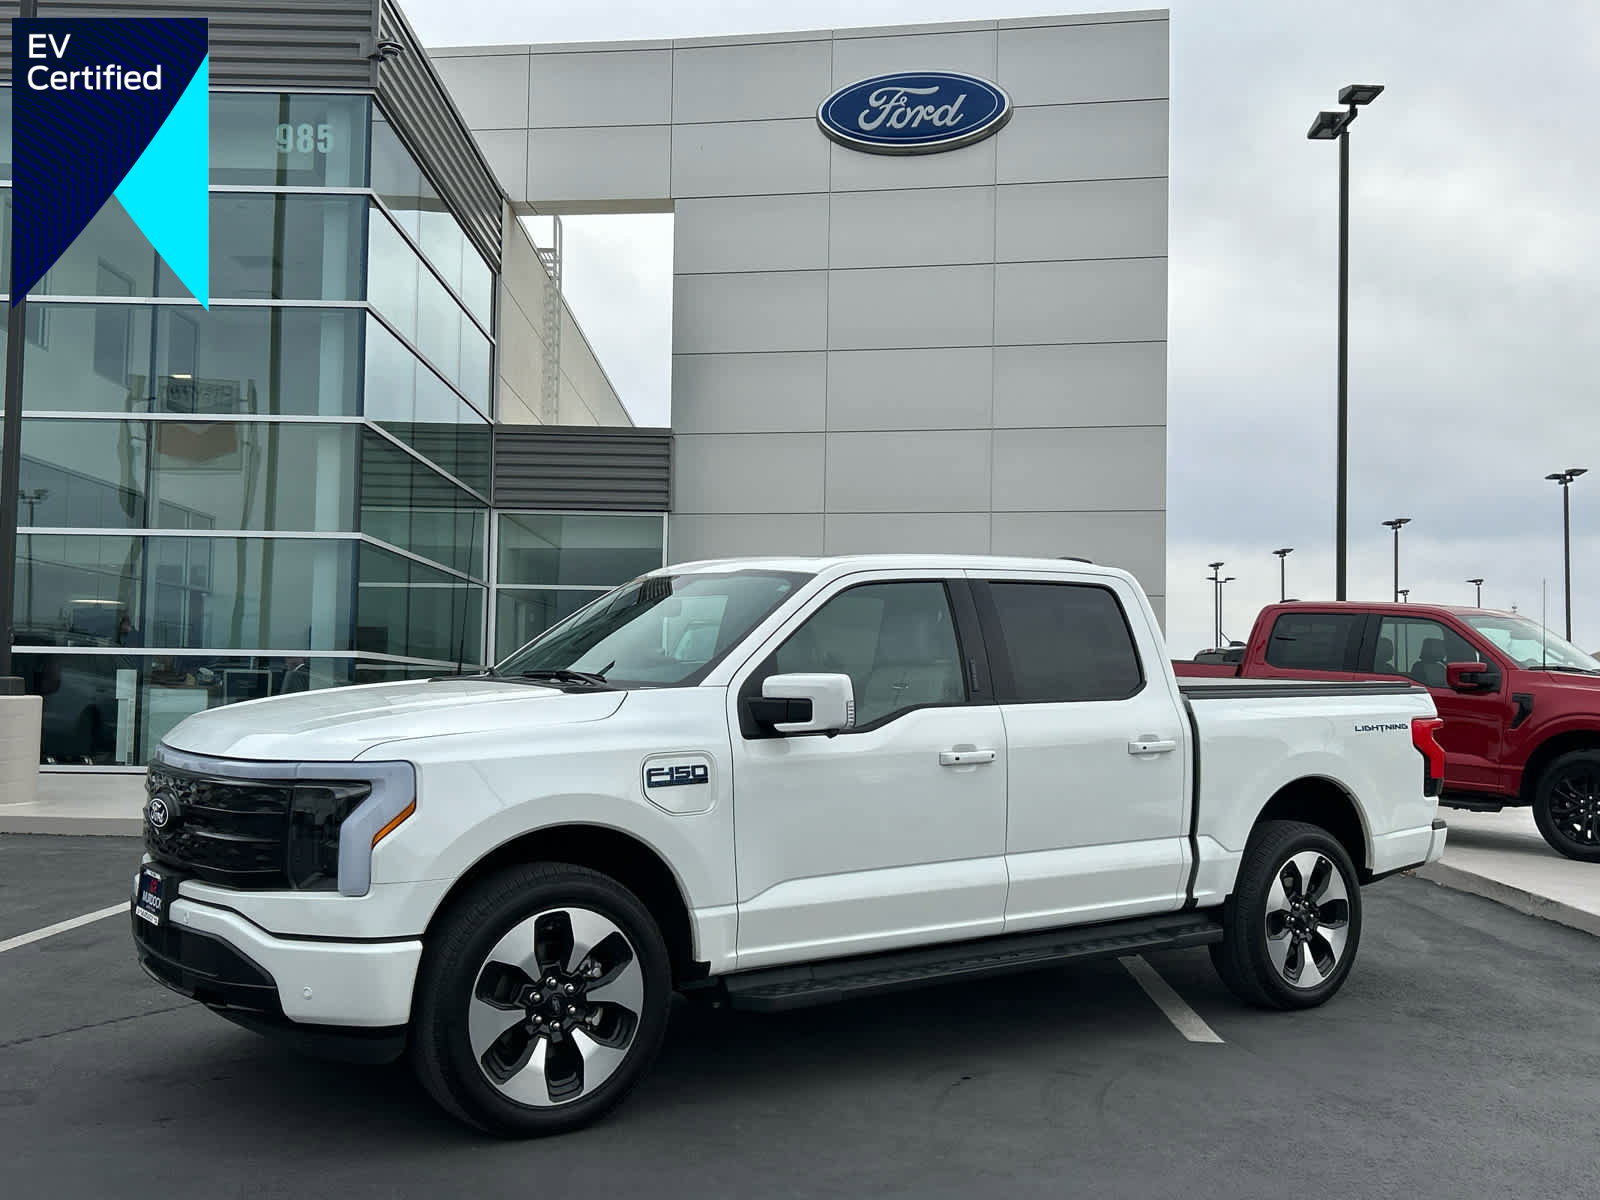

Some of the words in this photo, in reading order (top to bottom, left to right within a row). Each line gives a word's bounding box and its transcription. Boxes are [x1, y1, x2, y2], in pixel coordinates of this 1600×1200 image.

[857, 86, 968, 131] Ford
[275, 123, 335, 153] 985
[1354, 723, 1409, 733] LIGHTNING
